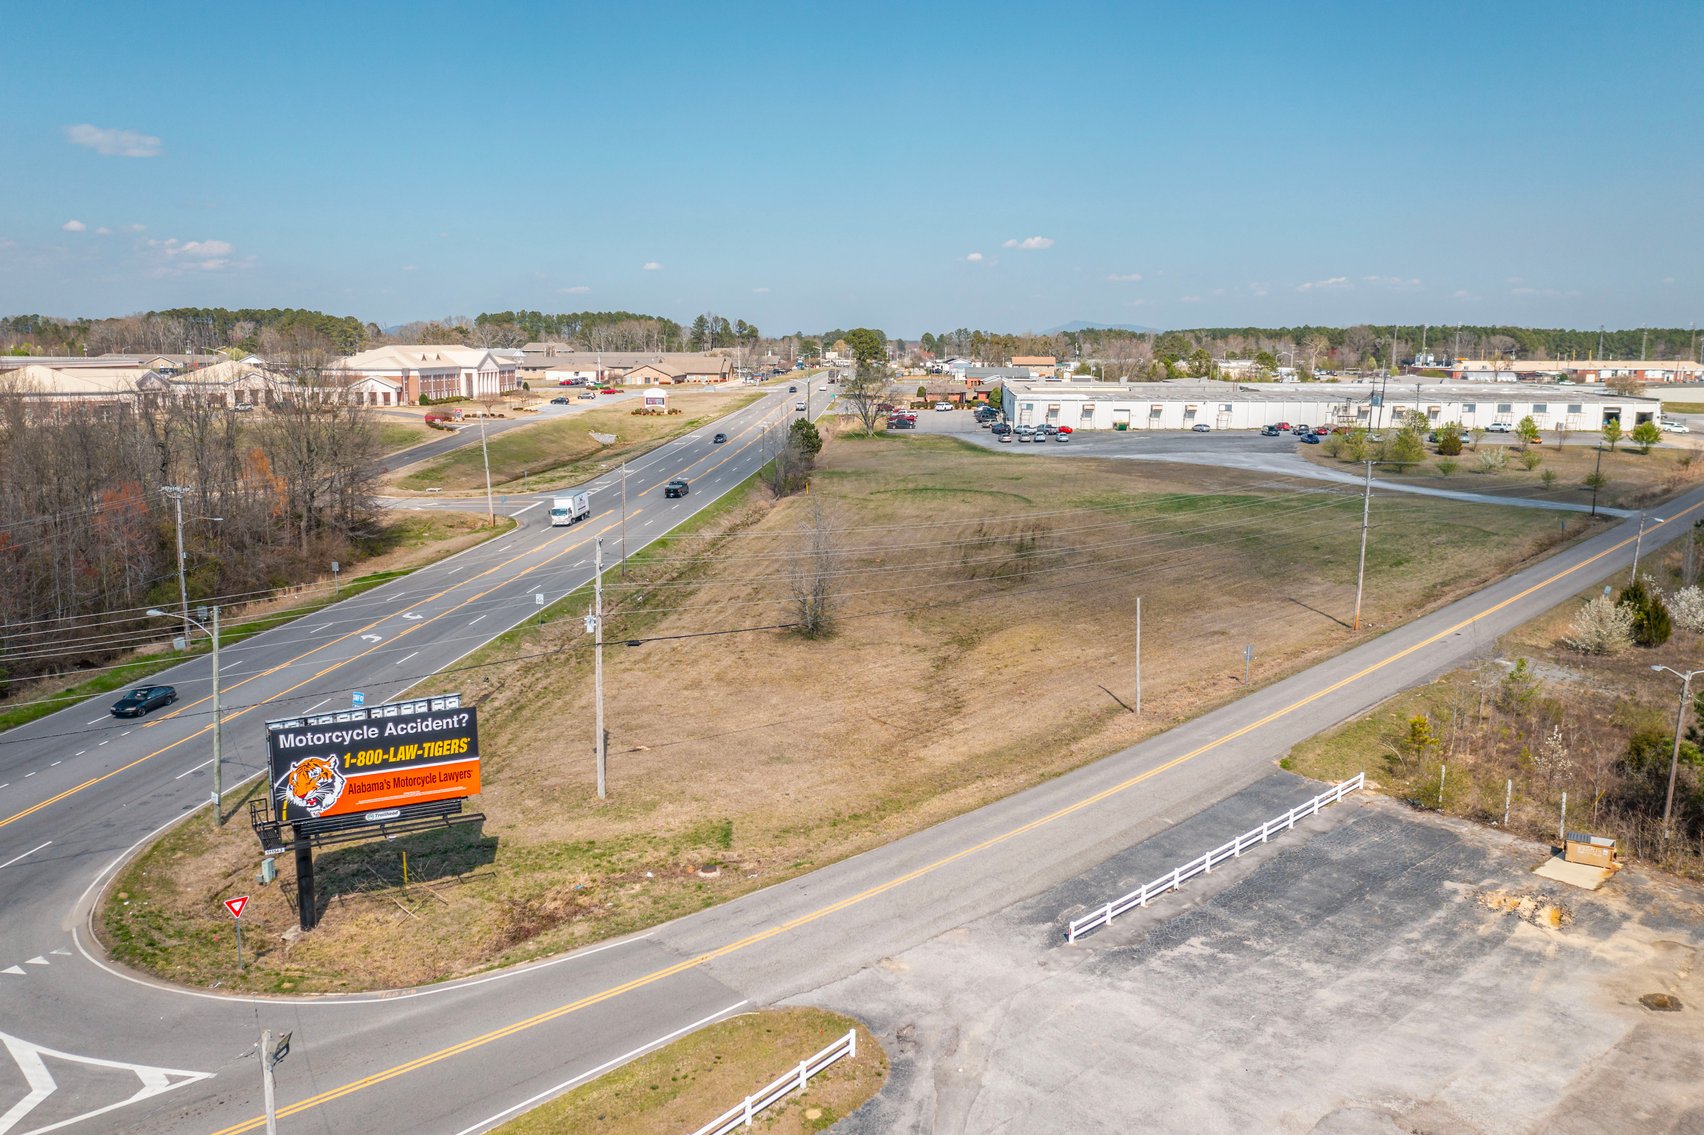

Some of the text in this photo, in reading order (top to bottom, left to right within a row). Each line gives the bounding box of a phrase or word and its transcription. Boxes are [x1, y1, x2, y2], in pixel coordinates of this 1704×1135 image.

[279, 713, 469, 749] Motorcycle Accident?
[343, 737, 469, 768] 1-800-LAW-TIGERS
[348, 769, 472, 795] Alabama's Motorcycle Lawyers
